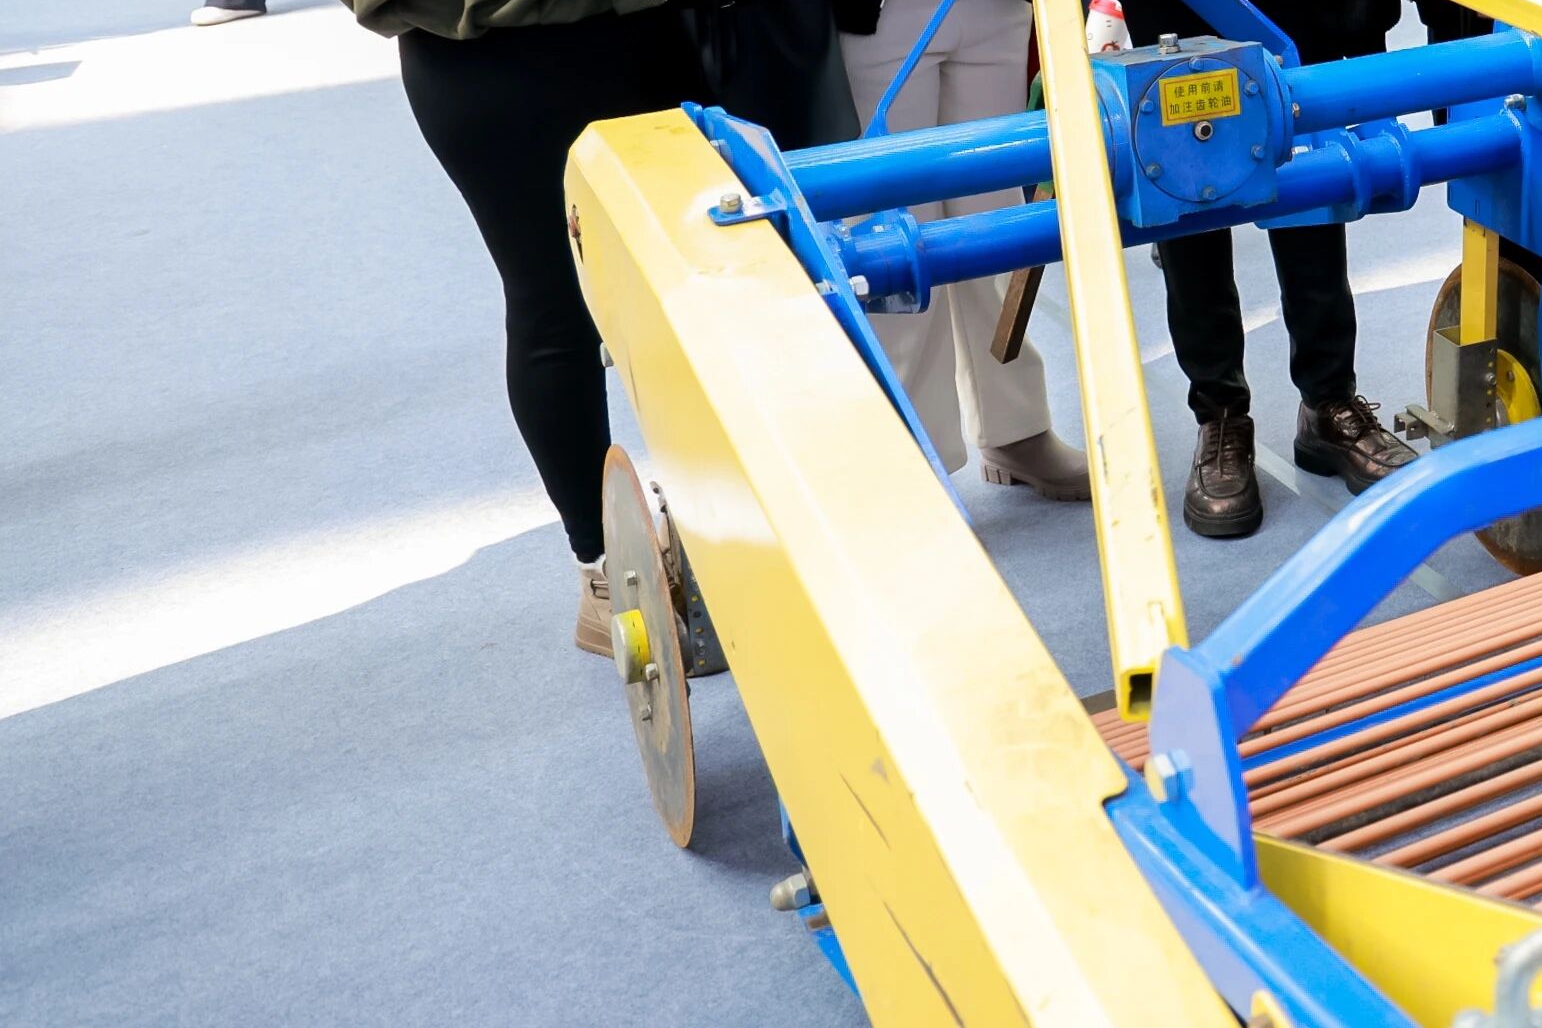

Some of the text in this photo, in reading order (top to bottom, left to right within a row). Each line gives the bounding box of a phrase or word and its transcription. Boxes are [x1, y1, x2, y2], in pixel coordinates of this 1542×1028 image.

[1174, 79, 1225, 99] 使用前请
[1168, 94, 1232, 116] 加注齿轮油
